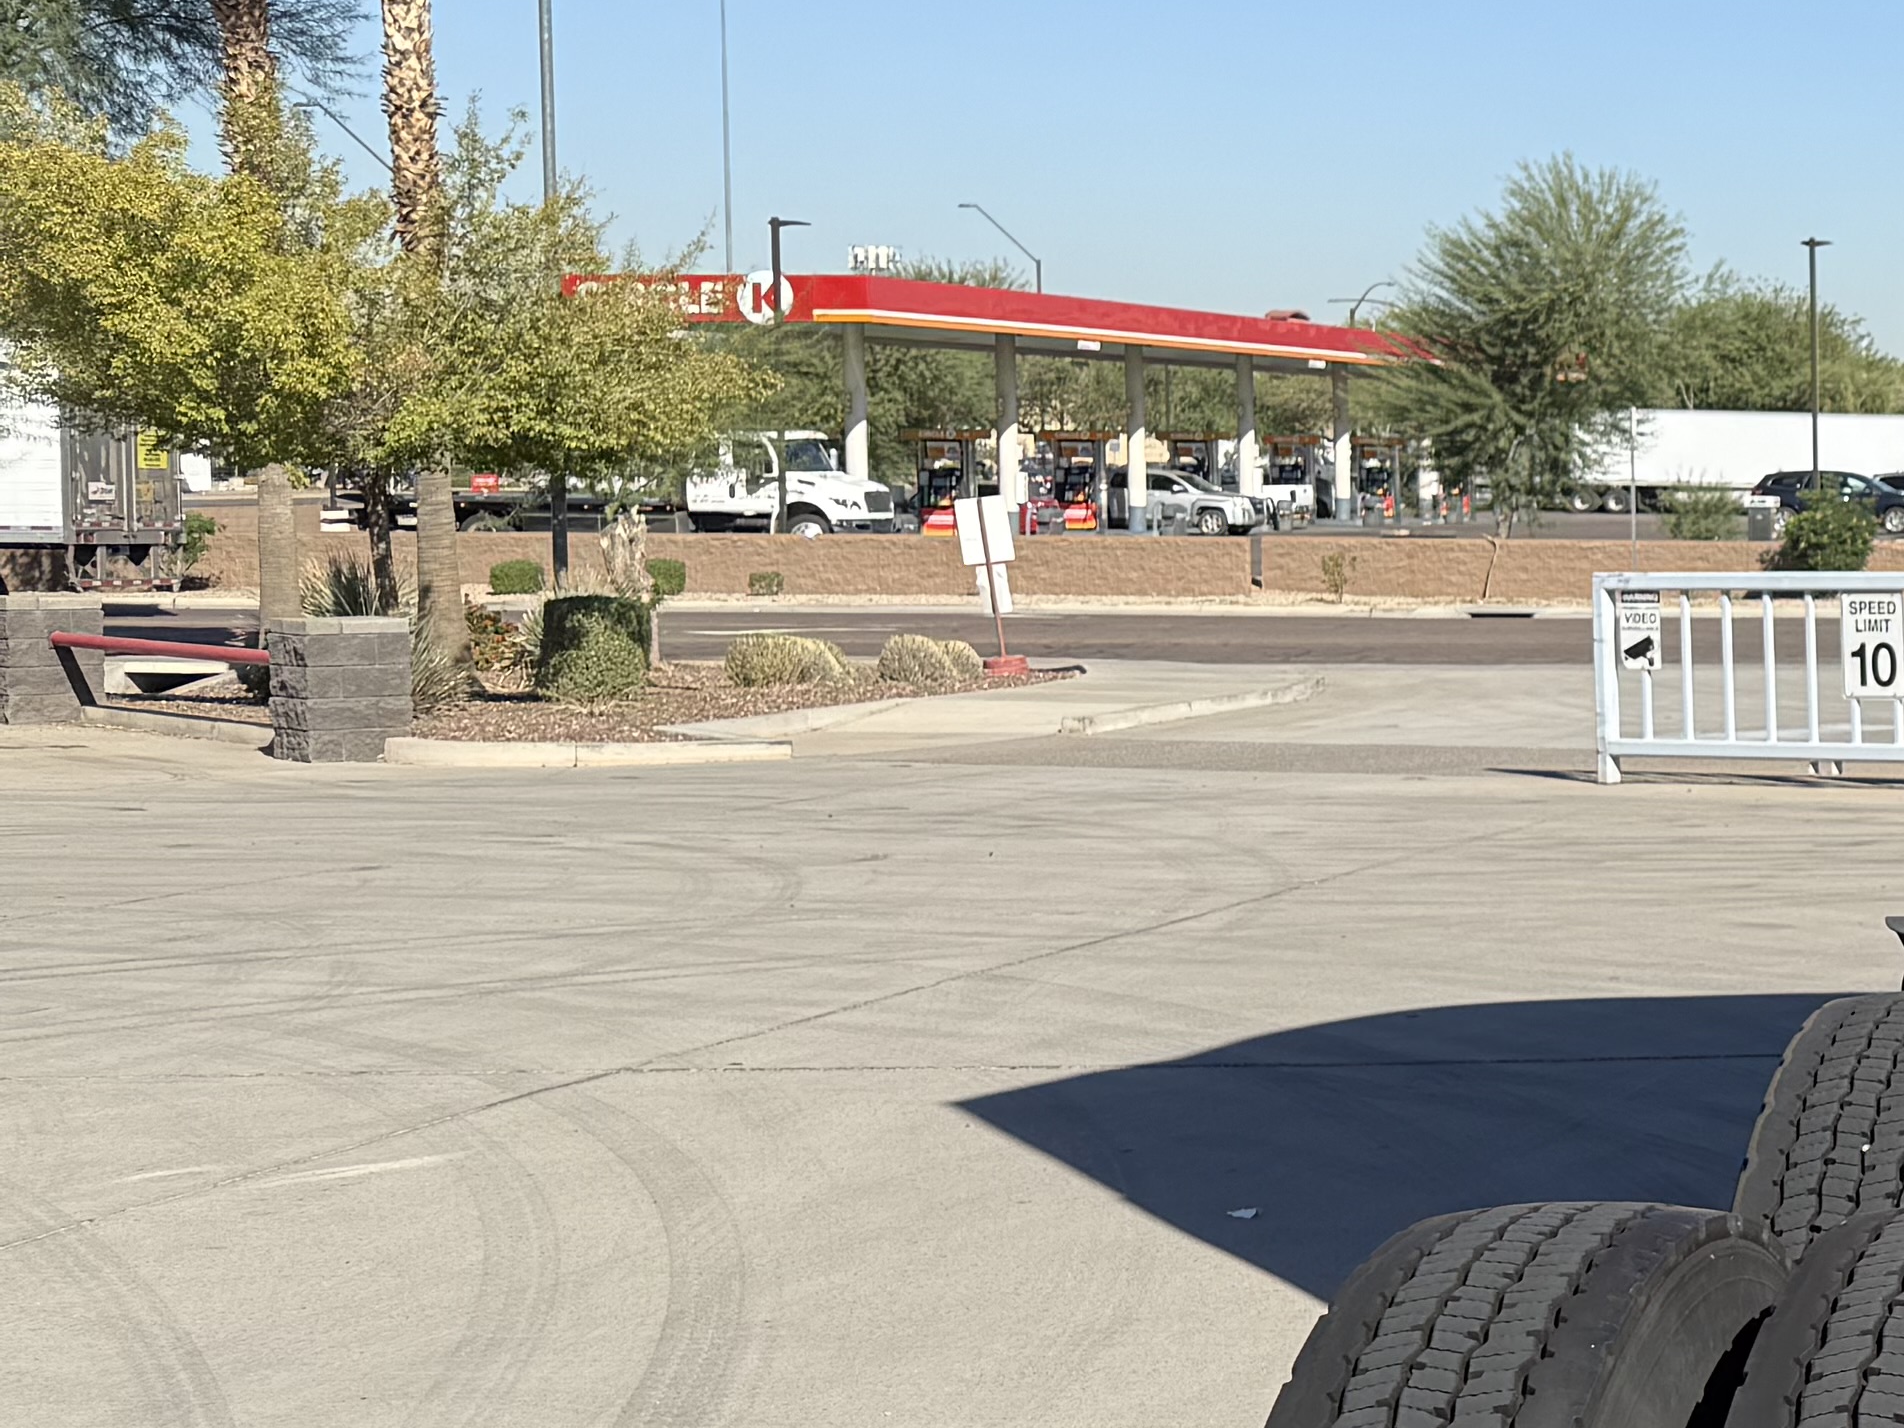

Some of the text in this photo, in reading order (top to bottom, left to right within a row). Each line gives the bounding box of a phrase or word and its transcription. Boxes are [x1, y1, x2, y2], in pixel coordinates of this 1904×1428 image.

[1849, 601, 1896, 615] SPEED
[1855, 619, 1891, 633] LIMIT
[1850, 642, 1897, 688] 10
